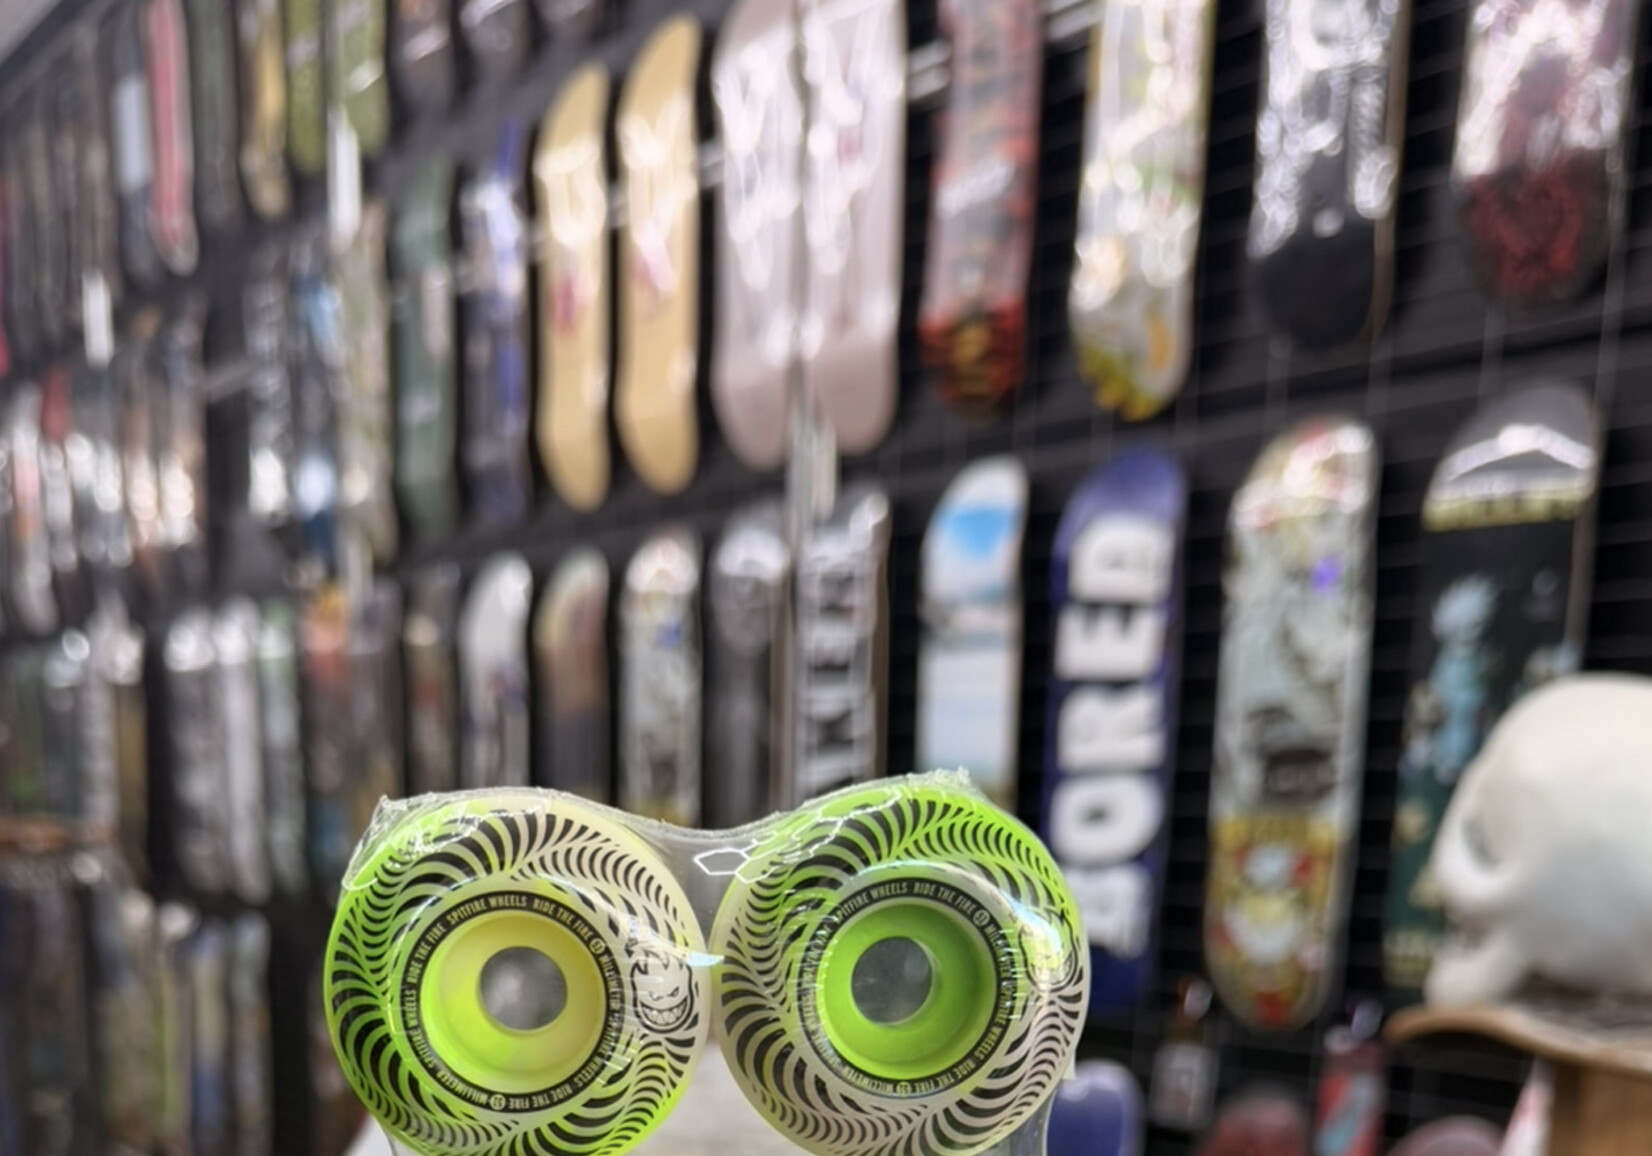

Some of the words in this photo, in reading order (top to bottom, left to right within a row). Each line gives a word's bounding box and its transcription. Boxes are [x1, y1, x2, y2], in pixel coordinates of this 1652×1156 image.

[1049, 512, 1175, 958] BORED
[869, 882, 906, 900] WHEELS
[914, 881, 935, 896] RIDE
[936, 886, 955, 903] THE
[488, 894, 527, 907] WHEELS
[533, 898, 555, 914] RIDE
[954, 895, 976, 915] FIRE
[445, 898, 486, 926] SPITFIRE
[556, 907, 574, 923] THE
[426, 923, 446, 943] FIRE
[573, 918, 594, 939] FIRE
[415, 942, 431, 960] THE
[406, 961, 422, 983] RIDE
[406, 989, 418, 1027] WHEELS
[974, 1026, 1002, 1060] WHEELS
[573, 1055, 604, 1086] WHEELS
[953, 1058, 976, 1078] RIDE
[914, 1079, 934, 1092] FIRE
[936, 1072, 954, 1087] THE
[532, 1093, 549, 1107] THE
[551, 1083, 572, 1101] RIDE
[509, 1098, 529, 1109] FIRE
